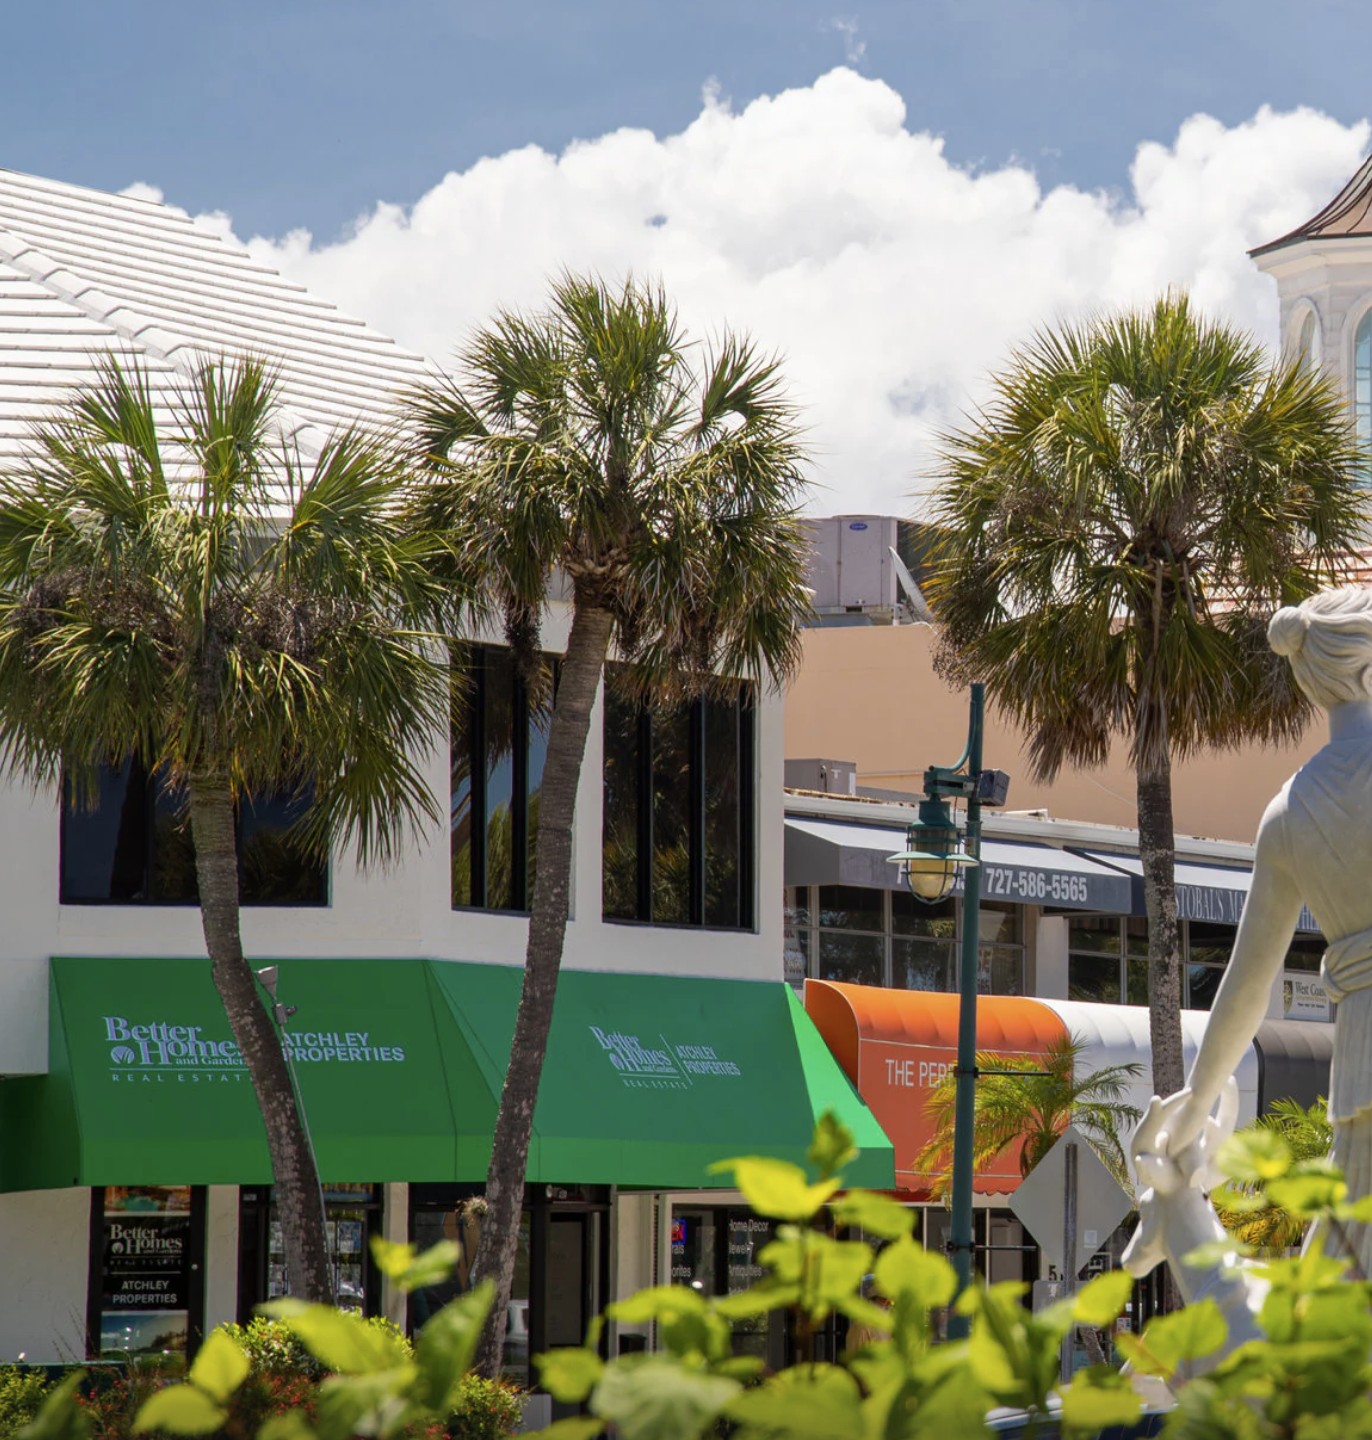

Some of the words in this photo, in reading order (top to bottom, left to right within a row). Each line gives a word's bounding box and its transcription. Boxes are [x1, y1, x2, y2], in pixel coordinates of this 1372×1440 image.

[986, 868, 1087, 901] 727-586-5565
[102, 1016, 202, 1042] Better
[281, 1032, 369, 1047] ATCHLEY
[588, 1025, 640, 1050] Better
[137, 1038, 243, 1065] Home
[282, 1047, 405, 1062] PROPERTIES
[614, 1046, 672, 1072] Homes
[675, 1045, 718, 1060] ATCHLEY
[175, 1056, 198, 1065] and
[683, 1060, 741, 1076] PROPERTIES
[112, 1073, 165, 1082] REAL
[178, 1073, 252, 1082] ESTAT
[885, 1059, 914, 1087] THE
[110, 1223, 159, 1240] Better
[126, 1238, 183, 1255] Homes
[121, 1280, 170, 1290] ATCHLEY
[112, 1293, 178, 1304] PROPERTIES
